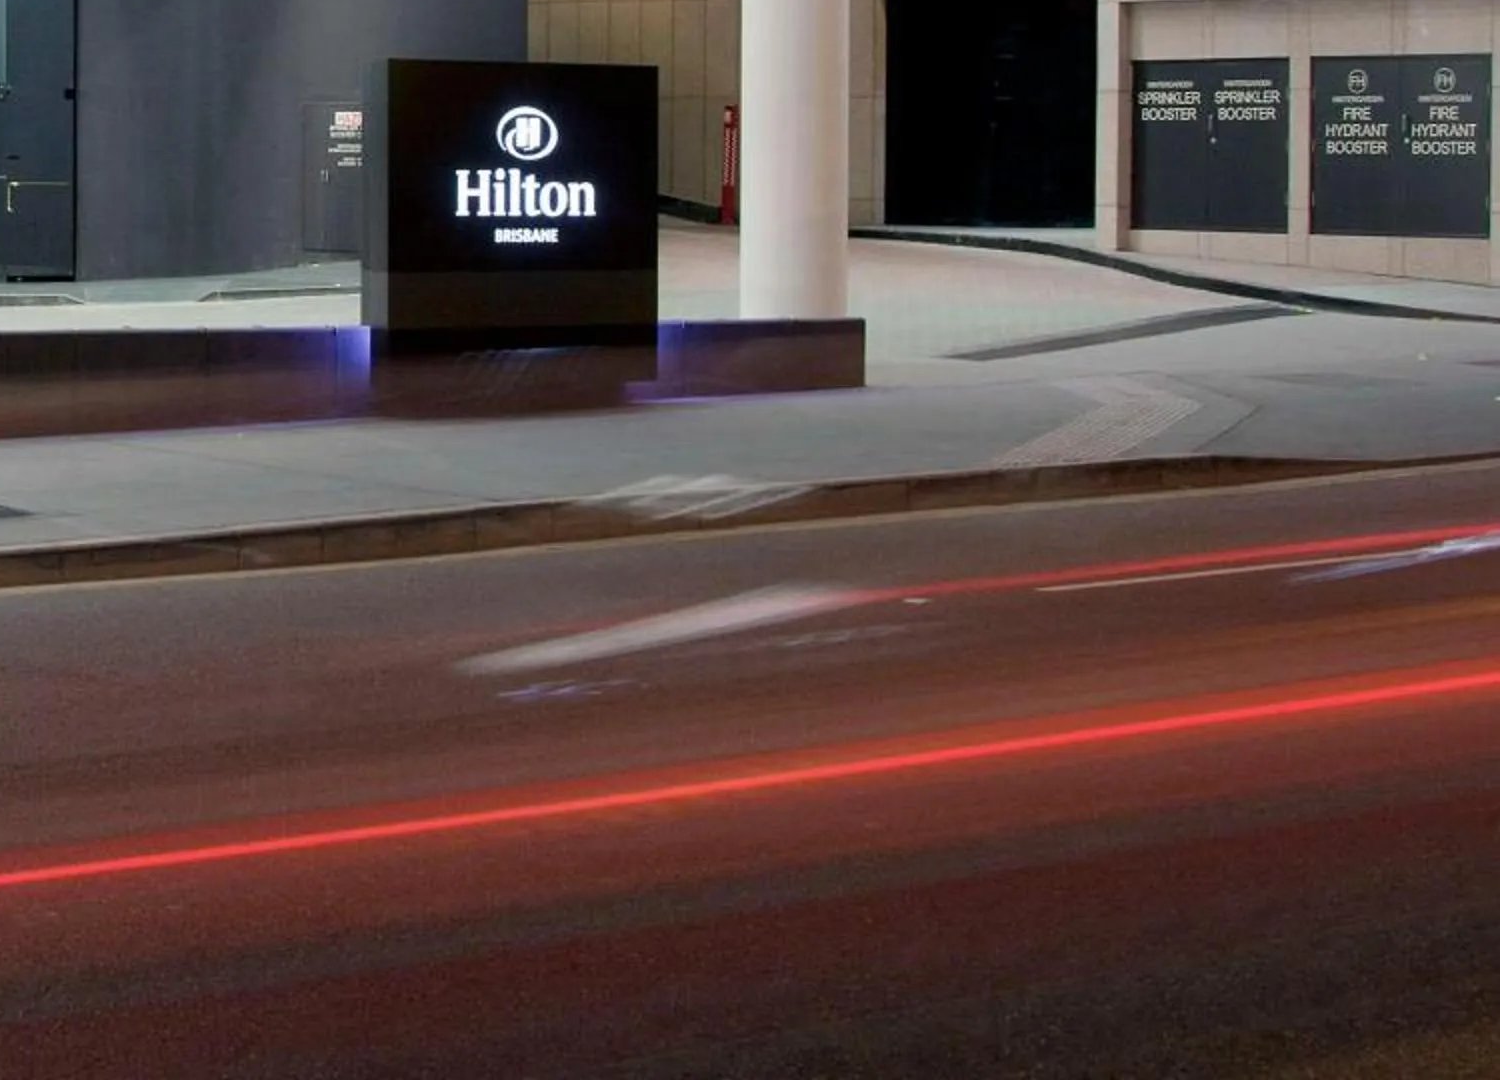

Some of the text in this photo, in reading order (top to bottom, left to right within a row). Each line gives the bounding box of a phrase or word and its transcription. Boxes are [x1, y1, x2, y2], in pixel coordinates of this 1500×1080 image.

[1138, 91, 1201, 105] SPRINKLER
[1214, 90, 1281, 104] SPRINKLER
[1141, 108, 1197, 121] BOOSTER
[1217, 107, 1277, 121] BOOSTER
[1343, 106, 1373, 121] FIRE
[1429, 106, 1460, 121] FIRE
[1325, 124, 1389, 137] HYDRANT
[1411, 123, 1477, 137] HYDRANT
[1325, 140, 1389, 155] BOOSTER
[1411, 140, 1477, 155] BOOSTER
[455, 168, 597, 218] Hilton
[495, 227, 559, 243] BRISBANE
